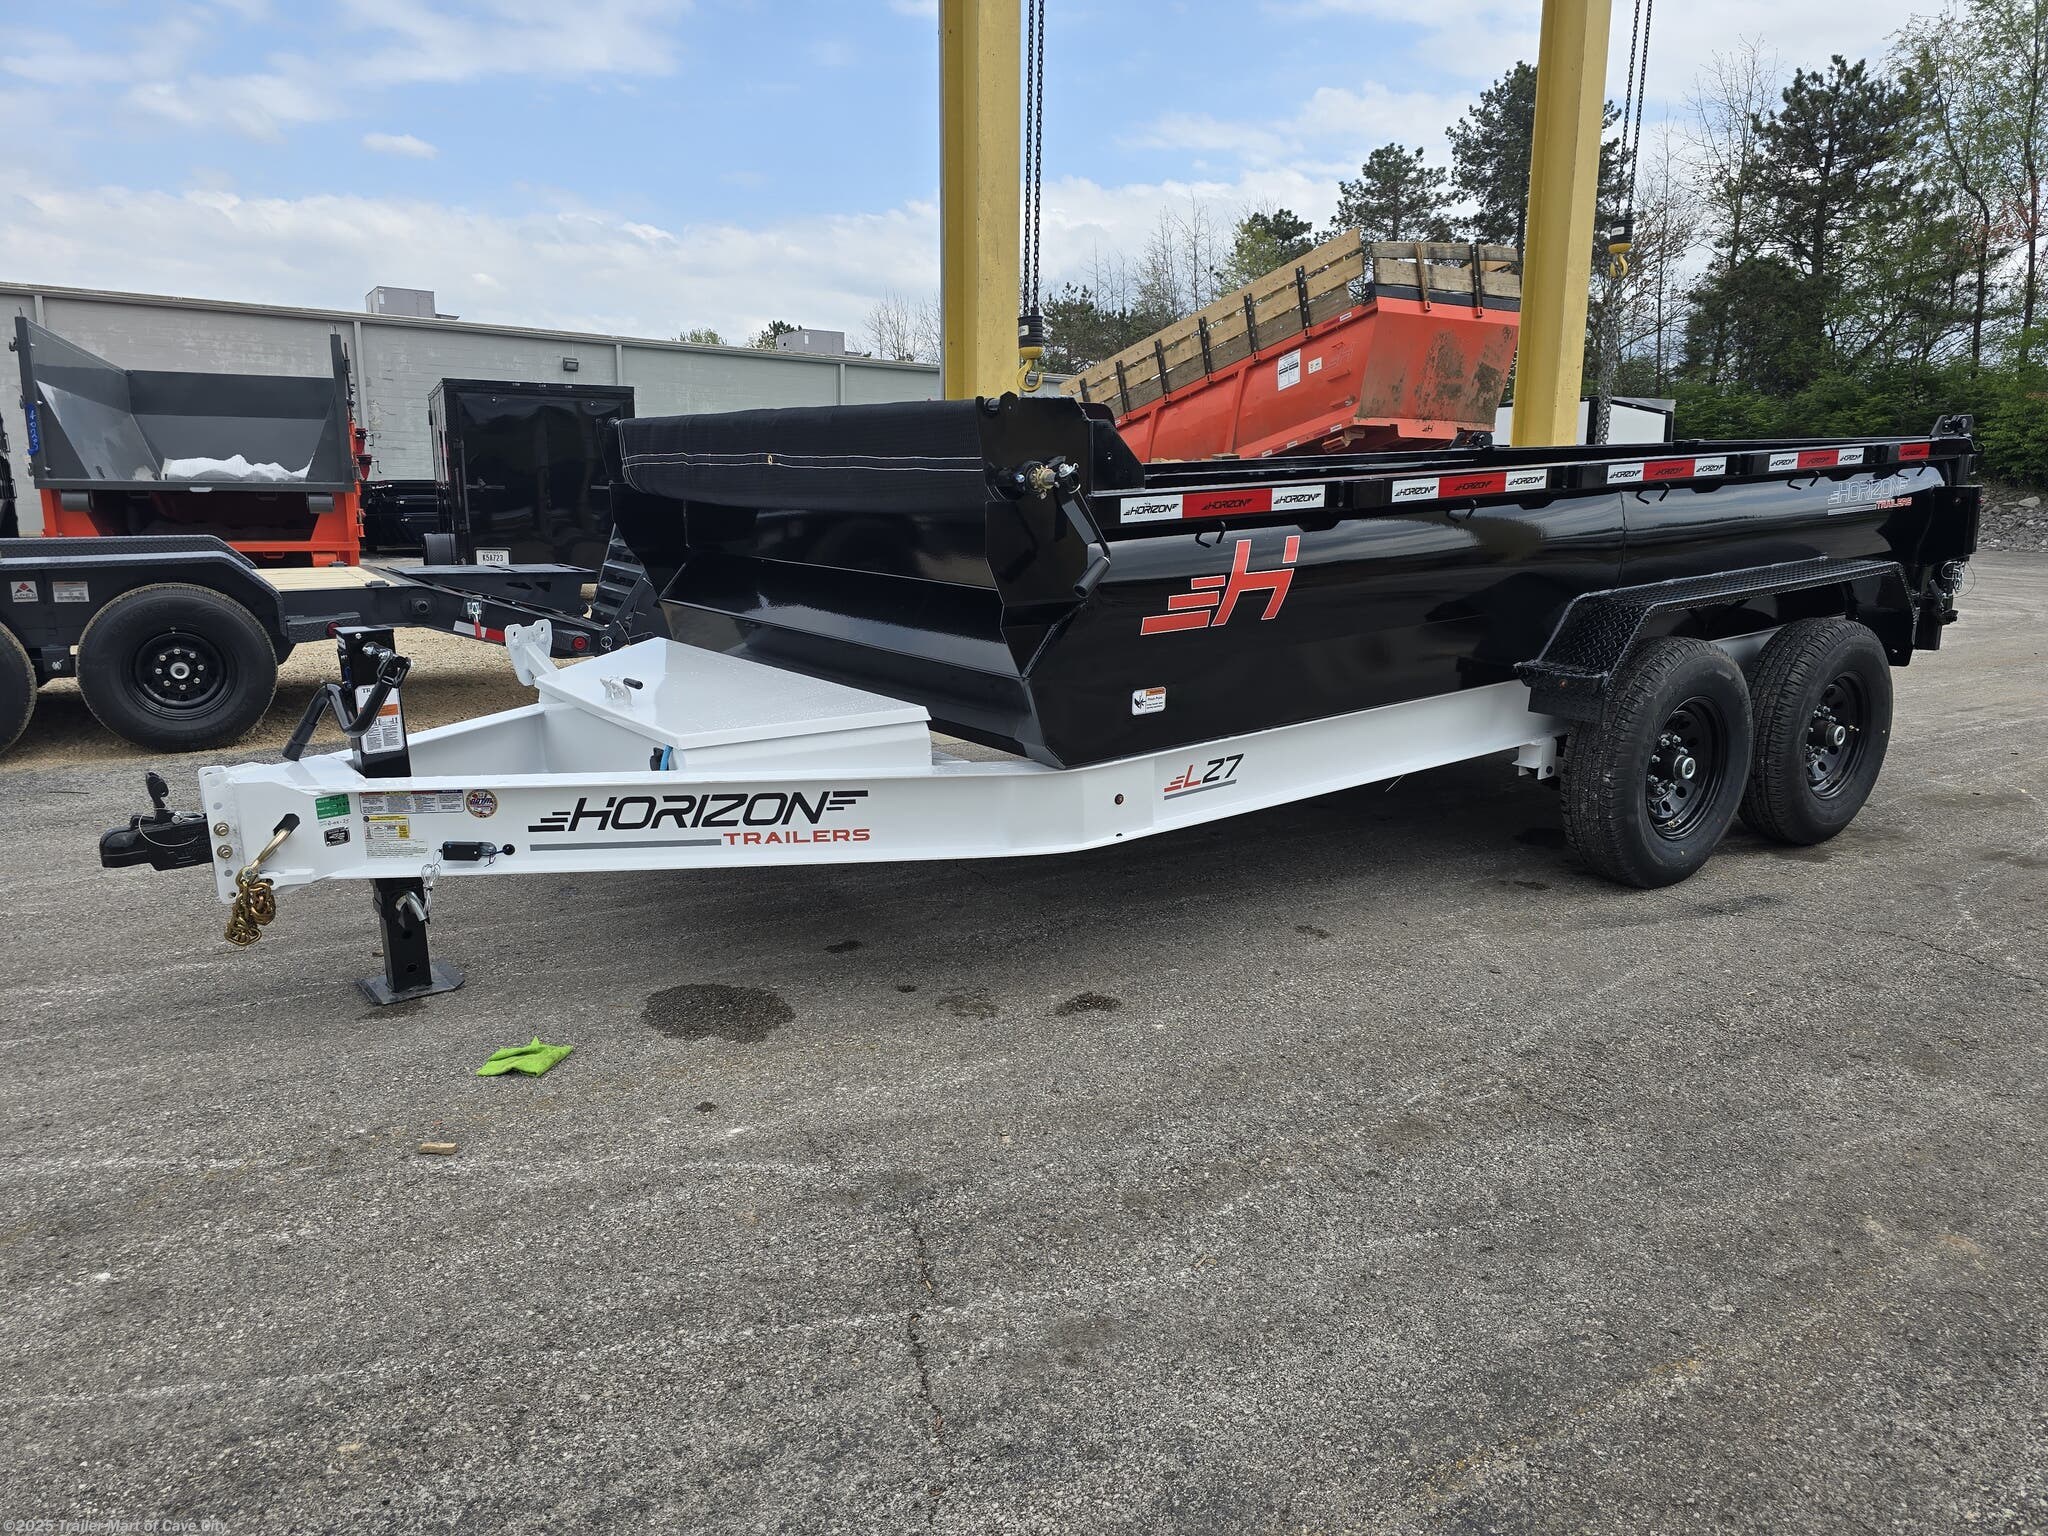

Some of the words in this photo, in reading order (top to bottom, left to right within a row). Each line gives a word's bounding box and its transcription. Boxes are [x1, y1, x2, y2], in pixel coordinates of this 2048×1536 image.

[1458, 481, 1489, 491] HORIZON
[1512, 476, 1540, 486] HORIZON
[1400, 486, 1432, 497] HORIZON
[1838, 477, 1902, 503] HORIZON
[1206, 499, 1248, 510] HORIZON
[1279, 493, 1316, 504] HORIZON
[1876, 497, 1912, 509] TRAILERS
[1130, 503, 1172, 515] HORIZON
[1183, 753, 1244, 788] L27
[567, 791, 832, 831] HORIZON
[723, 828, 871, 846] TRAILERS
